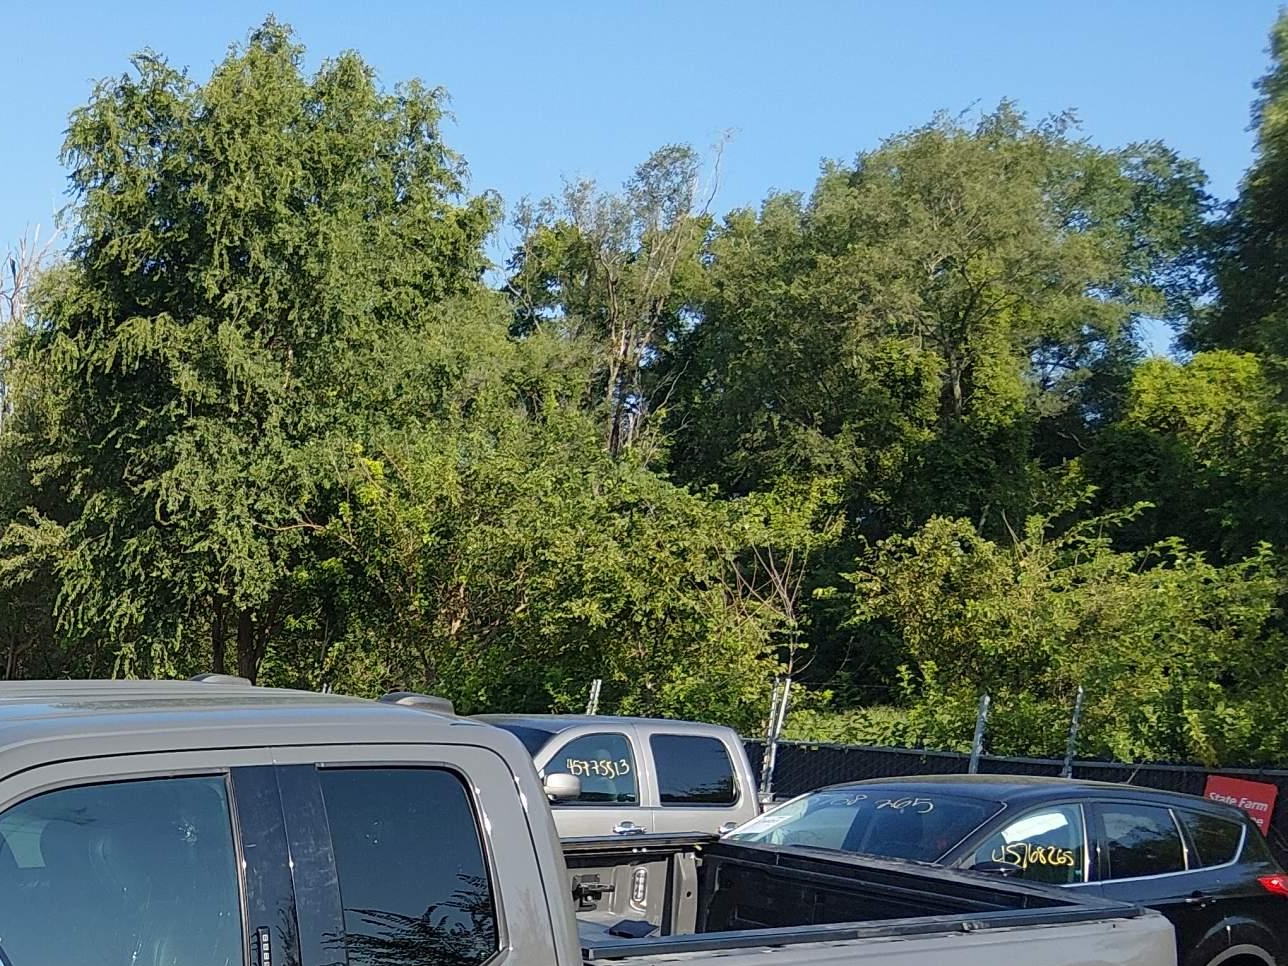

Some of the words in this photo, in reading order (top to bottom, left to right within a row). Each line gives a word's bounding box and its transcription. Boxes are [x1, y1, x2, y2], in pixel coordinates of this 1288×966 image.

[1209, 792, 1237, 805] State
[1237, 797, 1269, 811] Farm
[991, 842, 1074, 869] 45768265
